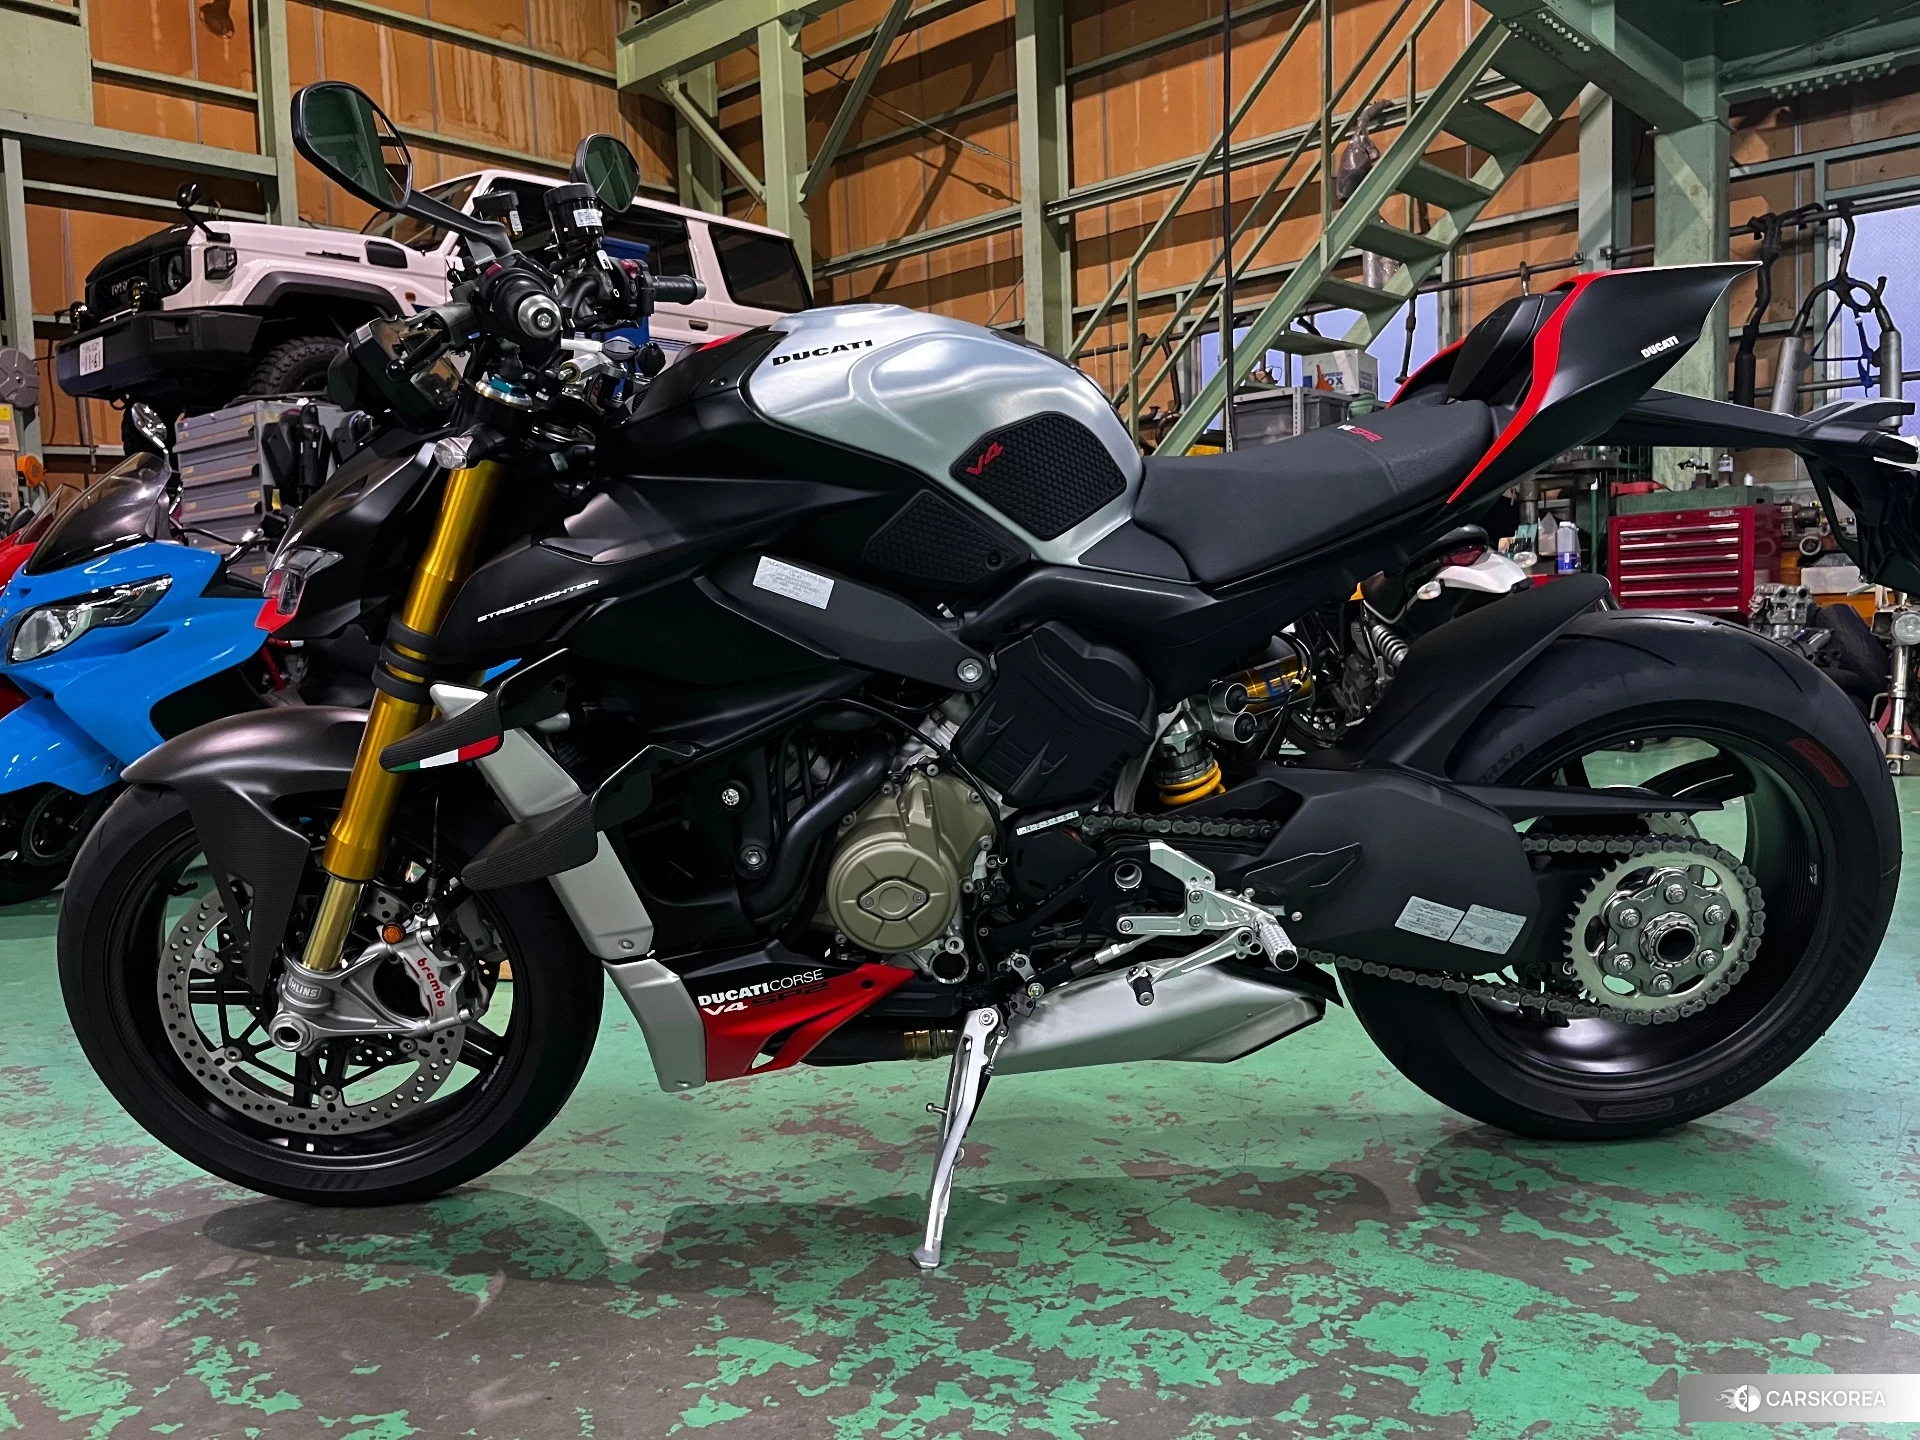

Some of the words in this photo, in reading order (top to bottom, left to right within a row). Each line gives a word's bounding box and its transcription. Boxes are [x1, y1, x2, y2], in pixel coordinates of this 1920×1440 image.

[771, 339, 873, 367] DUCATI
[1640, 335, 1680, 359] DUCATI
[965, 441, 1004, 476] V4
[477, 579, 600, 623] STREETFIGHTER
[416, 957, 446, 1008] brembo
[702, 1001, 749, 1016] V4
